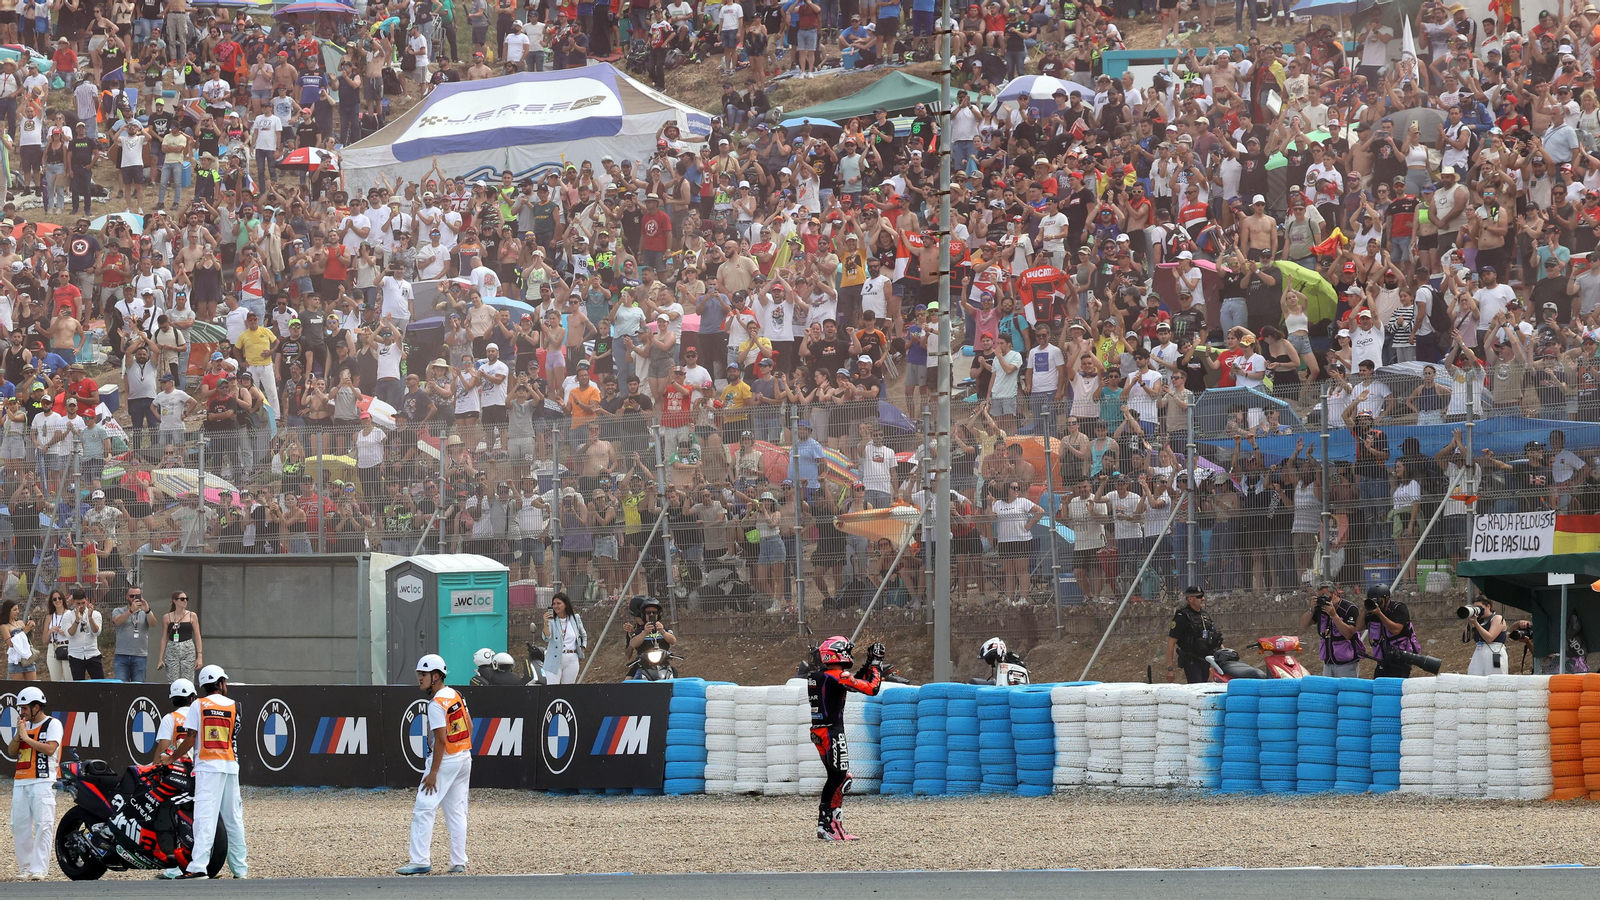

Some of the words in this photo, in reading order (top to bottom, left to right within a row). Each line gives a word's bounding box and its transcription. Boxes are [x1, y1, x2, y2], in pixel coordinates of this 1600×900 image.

[1476, 514, 1513, 531] GRADA
[1515, 512, 1554, 531] PELOUSSE
[1475, 533, 1499, 553] PIDE
[1501, 535, 1540, 553] PASILLO
[70, 711, 100, 748] M
[261, 702, 291, 722] BMW
[545, 702, 573, 722] BMW
[335, 717, 368, 754] M
[487, 717, 524, 756] M
[615, 715, 651, 754] M
[838, 732, 849, 771] aprilia
